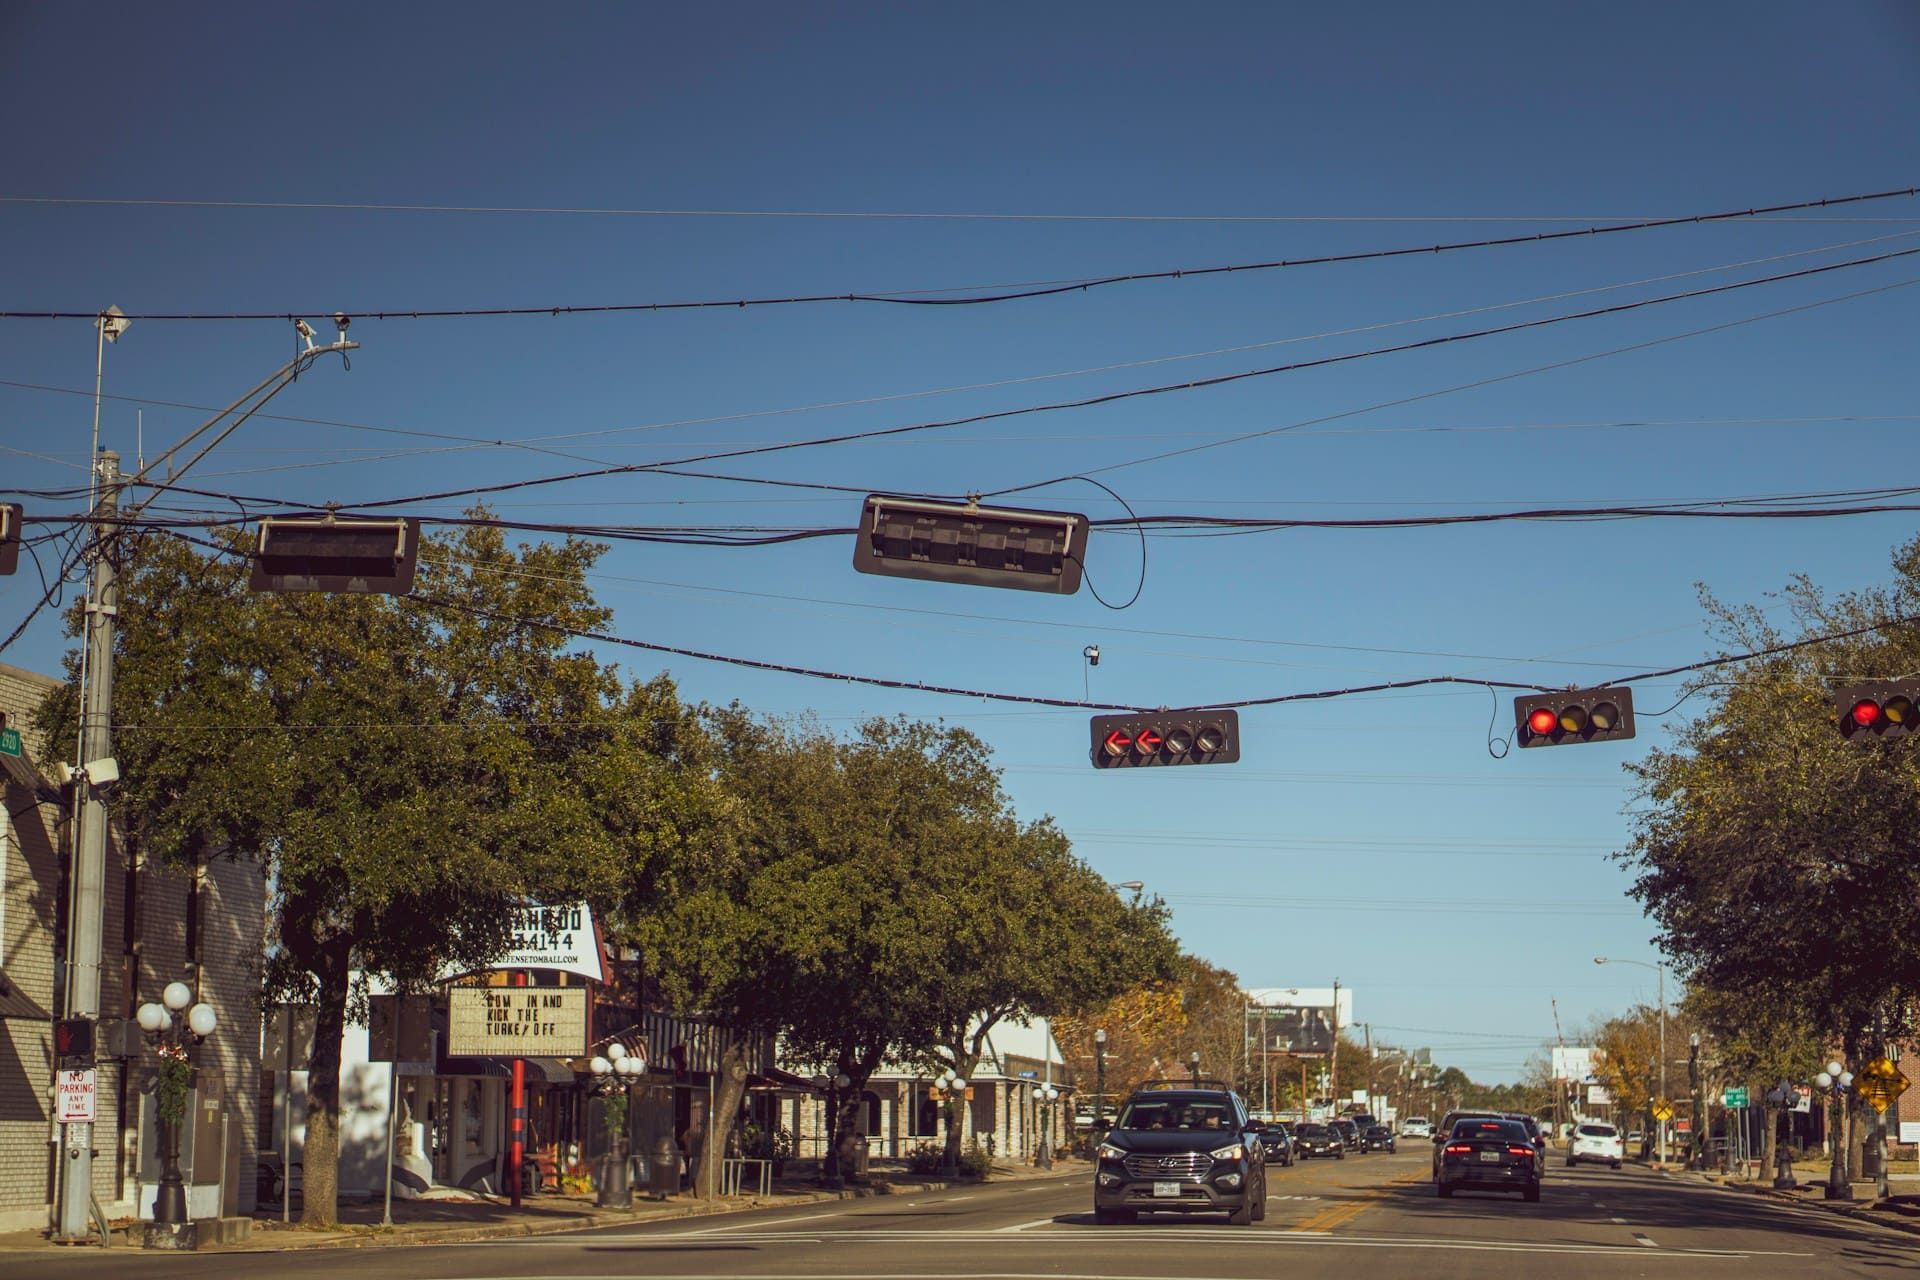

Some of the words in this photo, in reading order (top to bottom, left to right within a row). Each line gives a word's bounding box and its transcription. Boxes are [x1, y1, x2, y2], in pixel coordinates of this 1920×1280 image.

[527, 995, 538, 1008] IN
[543, 995, 562, 1008] AND
[487, 1009, 509, 1021] KICK
[517, 1009, 538, 1021] THE
[533, 1023, 555, 1036] OFF
[69, 1072, 84, 1082] NO
[60, 1084, 93, 1093] PARKING
